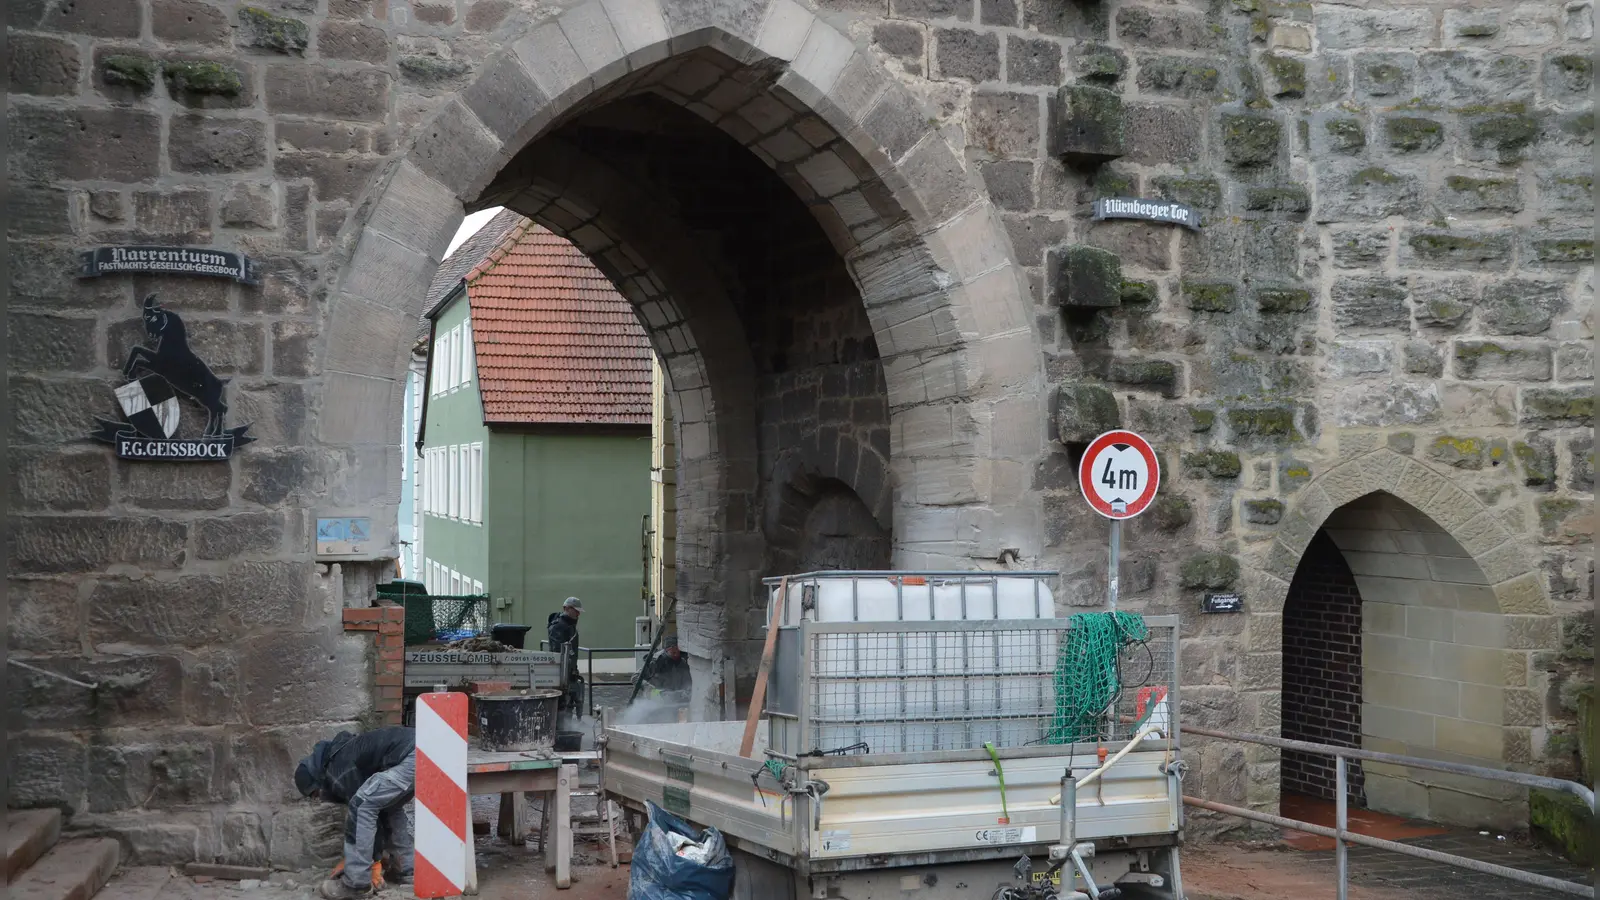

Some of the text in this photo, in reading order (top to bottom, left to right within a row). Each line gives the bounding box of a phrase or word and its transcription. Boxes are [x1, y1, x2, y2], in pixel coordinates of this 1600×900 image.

[1105, 199, 1189, 221] Nürnberger Tor
[112, 247, 227, 265] Narrenturm
[412, 654, 464, 663] ZEUSSEL
